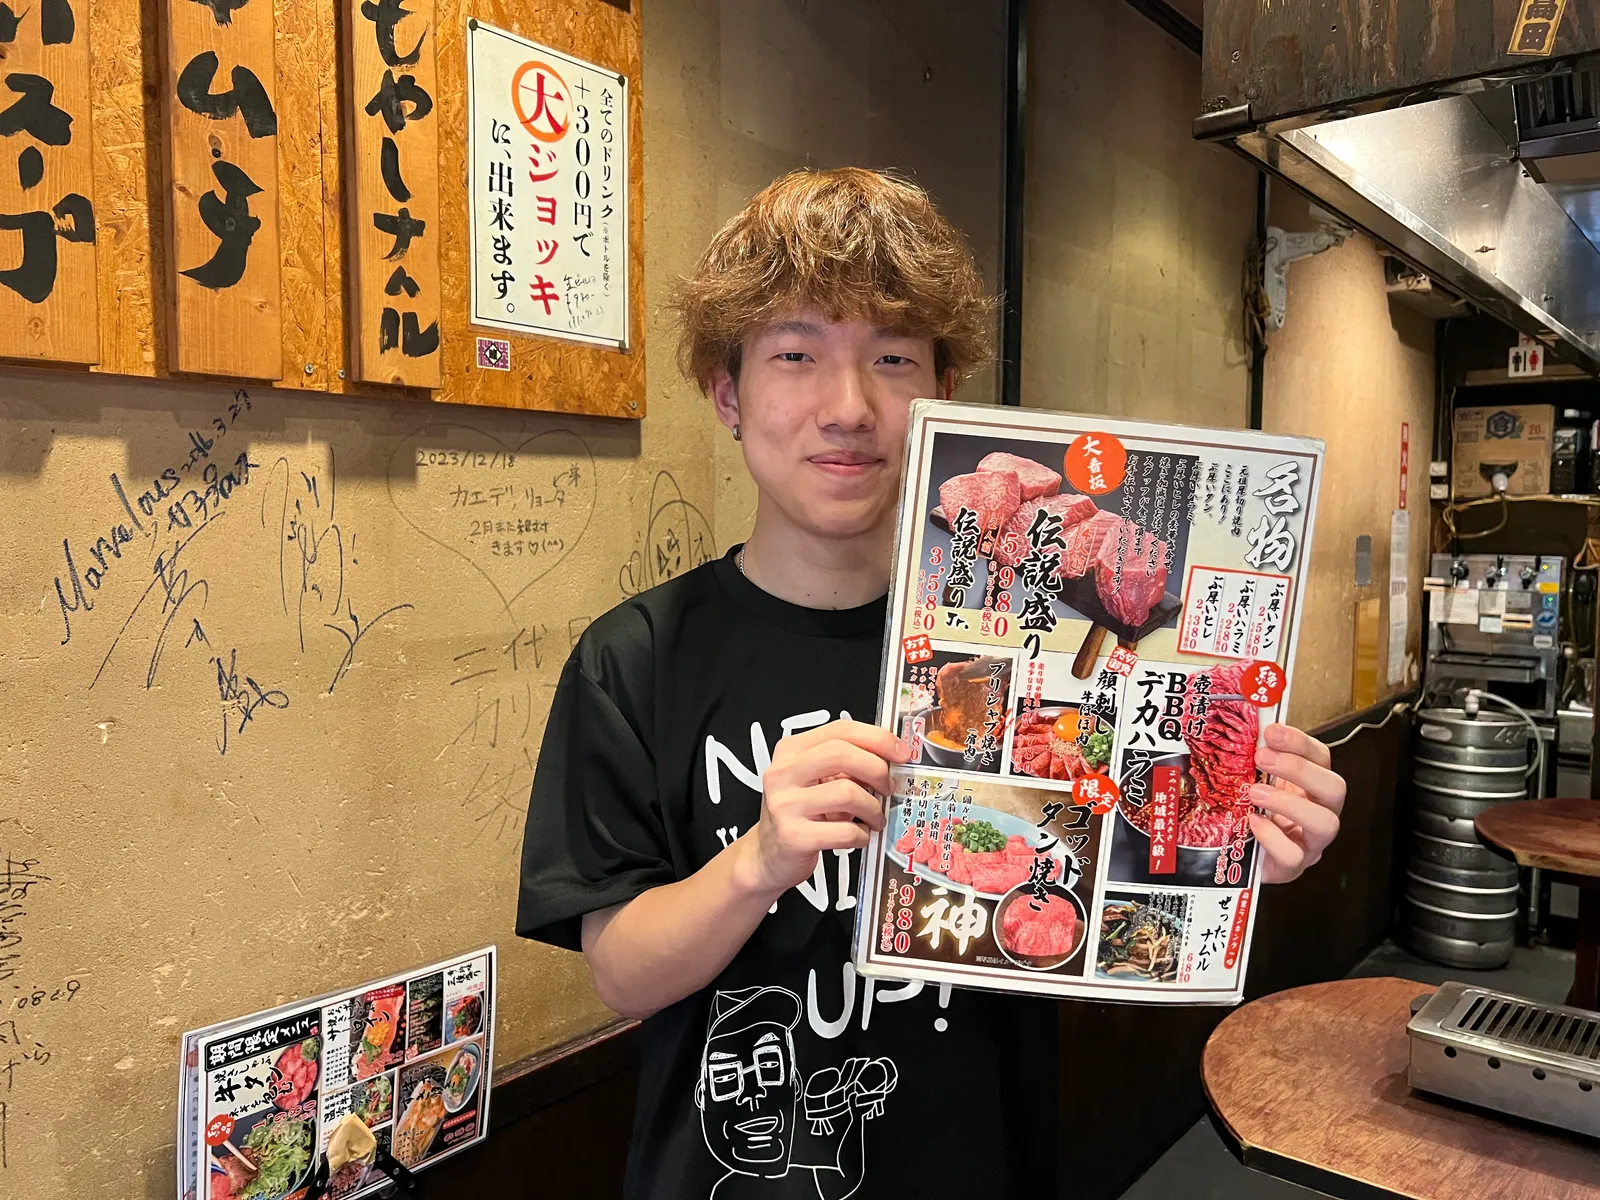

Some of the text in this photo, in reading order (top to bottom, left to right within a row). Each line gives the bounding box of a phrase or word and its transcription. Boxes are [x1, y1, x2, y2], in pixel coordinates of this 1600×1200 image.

[0, 0, 96, 303] スープ
[178, 0, 277, 289] ムチ
[487, 118, 515, 314] に、出来ます。
[519, 71, 567, 317] 大ジョッキ
[1244, 460, 1300, 572] 名物
[922, 546, 945, 632] 3,580
[993, 533, 1022, 638] 5,980
[1017, 507, 1068, 660] 伝説盛り
[1202, 575, 1224, 639] ぶ厚いヒレ
[1232, 580, 1255, 654] ぶ厚いハラミ
[1262, 583, 1285, 649] ぶ厚いタン
[1189, 599, 1205, 650] 2,380
[1221, 602, 1236, 653] 2,280
[1251, 606, 1267, 657] 2,580
[1096, 669, 1118, 735] 顔刺し
[1158, 672, 1187, 742] BBQ
[1250, 665, 1278, 704] 絶品
[910, 721, 923, 761] 780
[1126, 670, 1165, 807] デカハラミ
[1079, 779, 1115, 808] 限定
[1028, 801, 1064, 912] タン焼き
[1063, 799, 1098, 885] ゴッド
[894, 852, 922, 954] 1,980
[915, 885, 989, 957] 神
[1213, 896, 1233, 953] ぜったい
[1183, 952, 1194, 983] 680
[1196, 928, 1214, 972] ナムル
[209, 1016, 319, 1067] 期間限定メニュー
[214, 1066, 285, 1103] 牛タン
